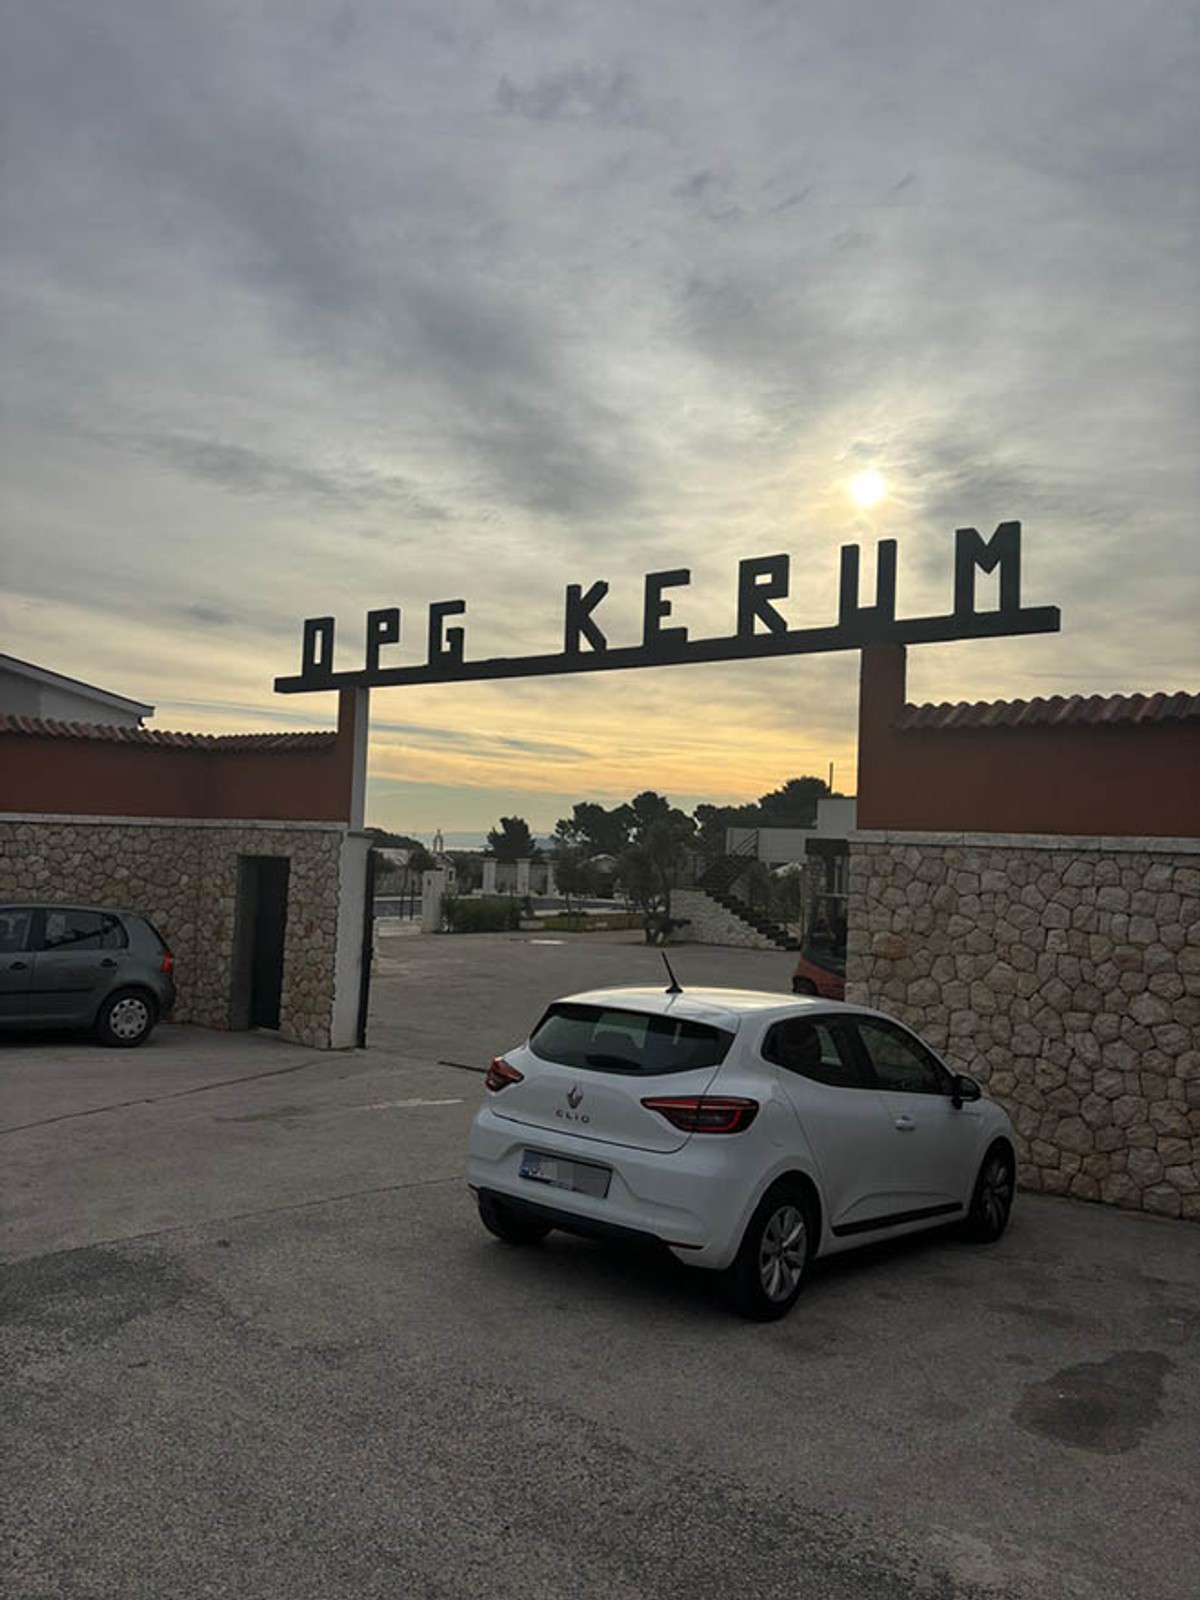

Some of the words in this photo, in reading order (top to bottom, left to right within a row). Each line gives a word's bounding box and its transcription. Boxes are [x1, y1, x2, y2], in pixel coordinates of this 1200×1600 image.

[302, 600, 466, 678] OPG
[564, 521, 1021, 656] KERUM
[555, 1108, 591, 1124] CLIO
